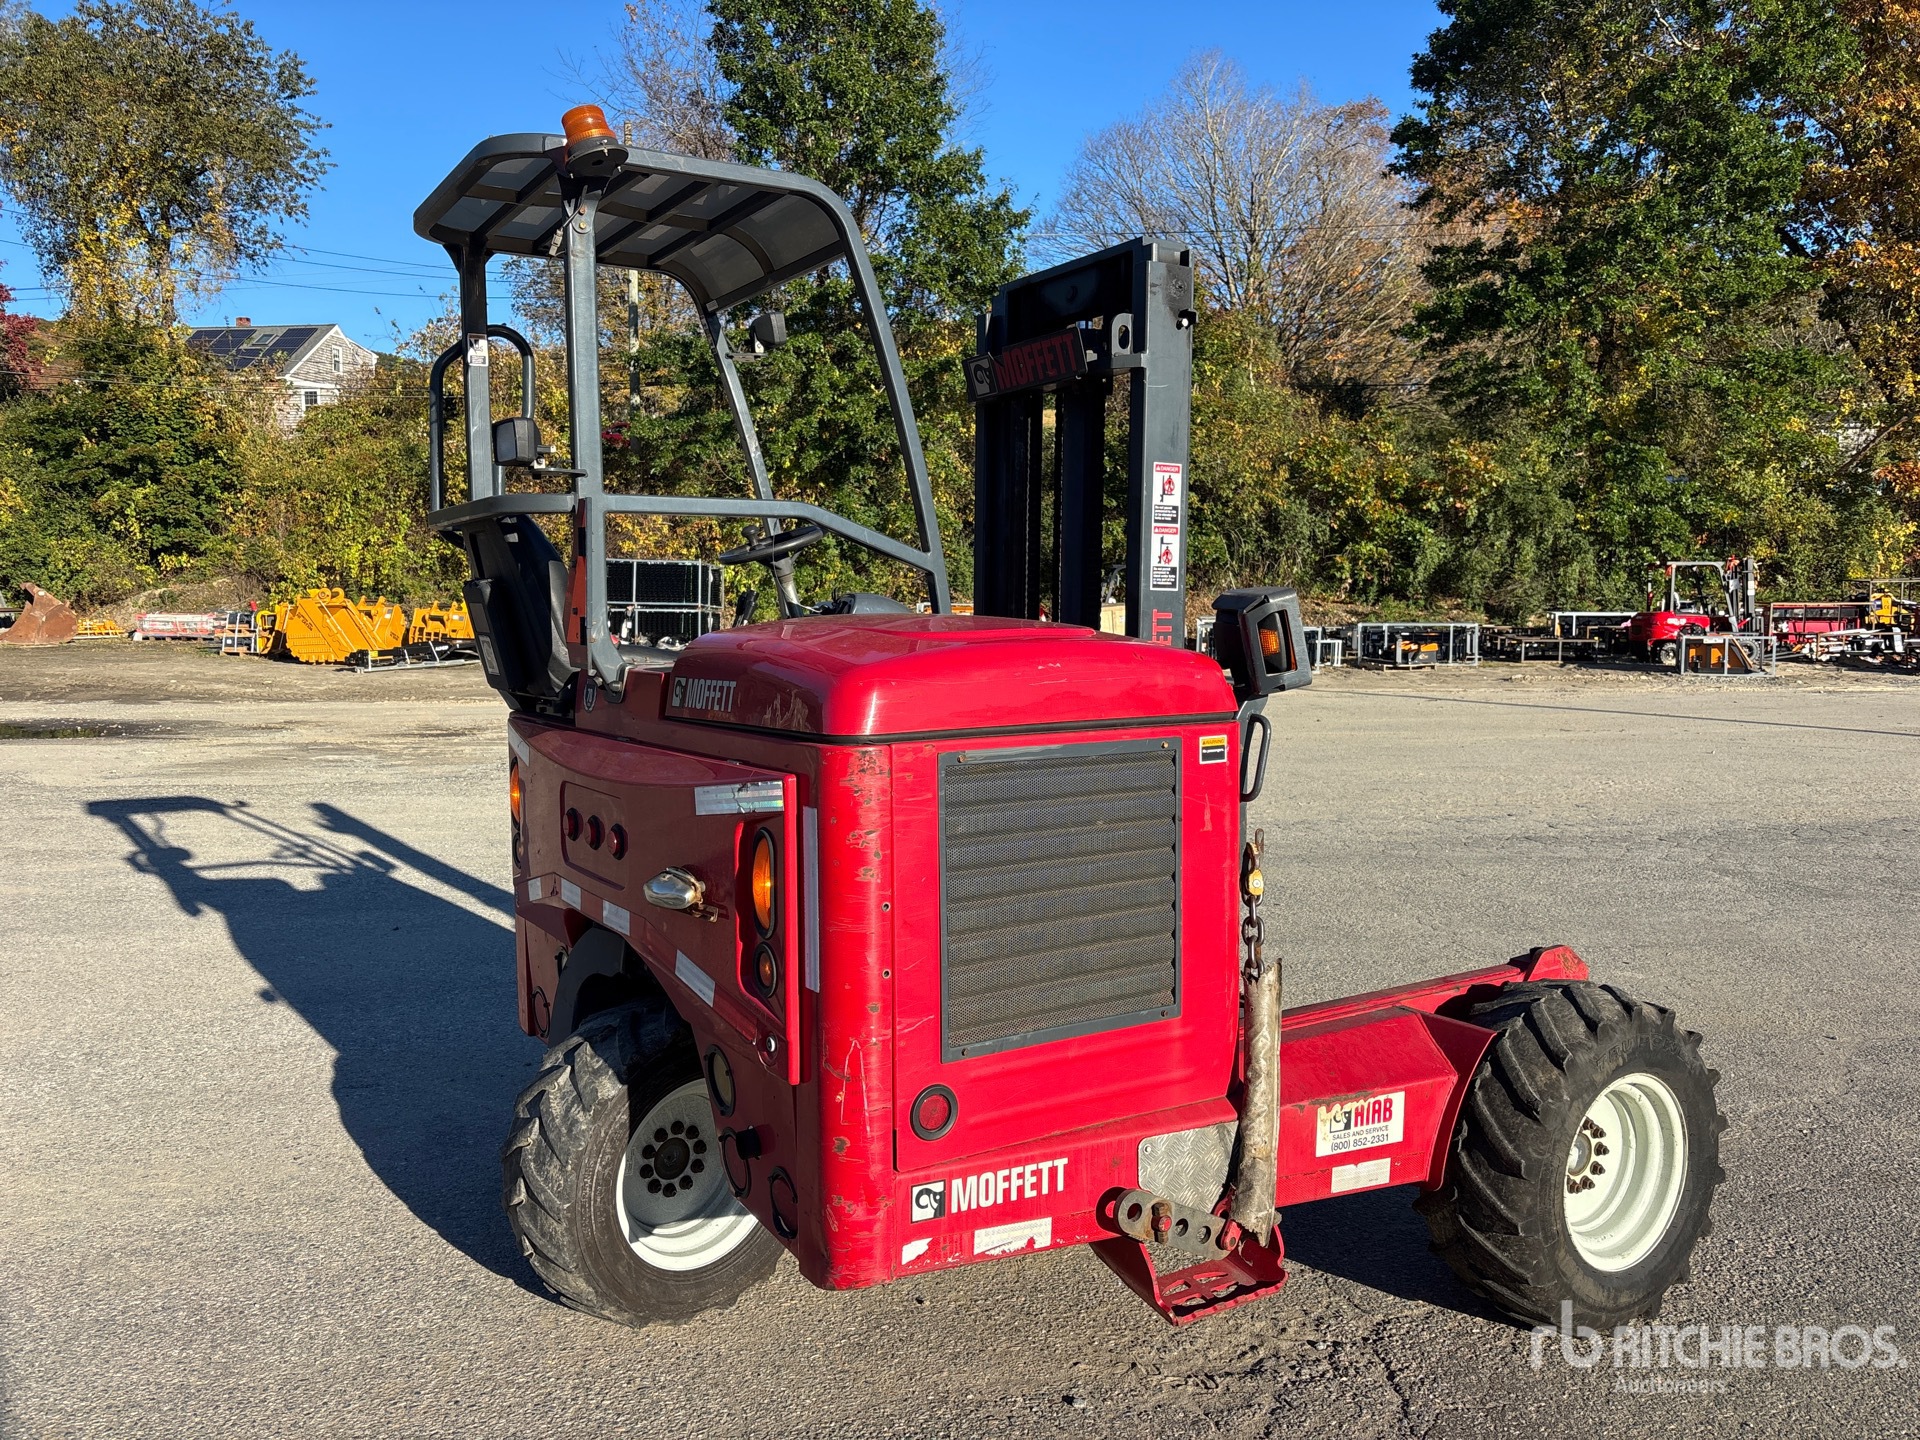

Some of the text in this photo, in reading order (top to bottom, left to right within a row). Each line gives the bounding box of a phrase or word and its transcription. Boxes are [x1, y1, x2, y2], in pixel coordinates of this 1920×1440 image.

[994, 332, 1078, 390] MOFFETT
[1152, 609, 1173, 646] ETT
[684, 678, 737, 713] MOFFETT
[1353, 1097, 1393, 1128] HIAB
[1331, 1133, 1389, 1153] (800) 852-2331
[1332, 1125, 1389, 1141] SALES AND SERVICE
[951, 1157, 1069, 1214] MOFFETT
